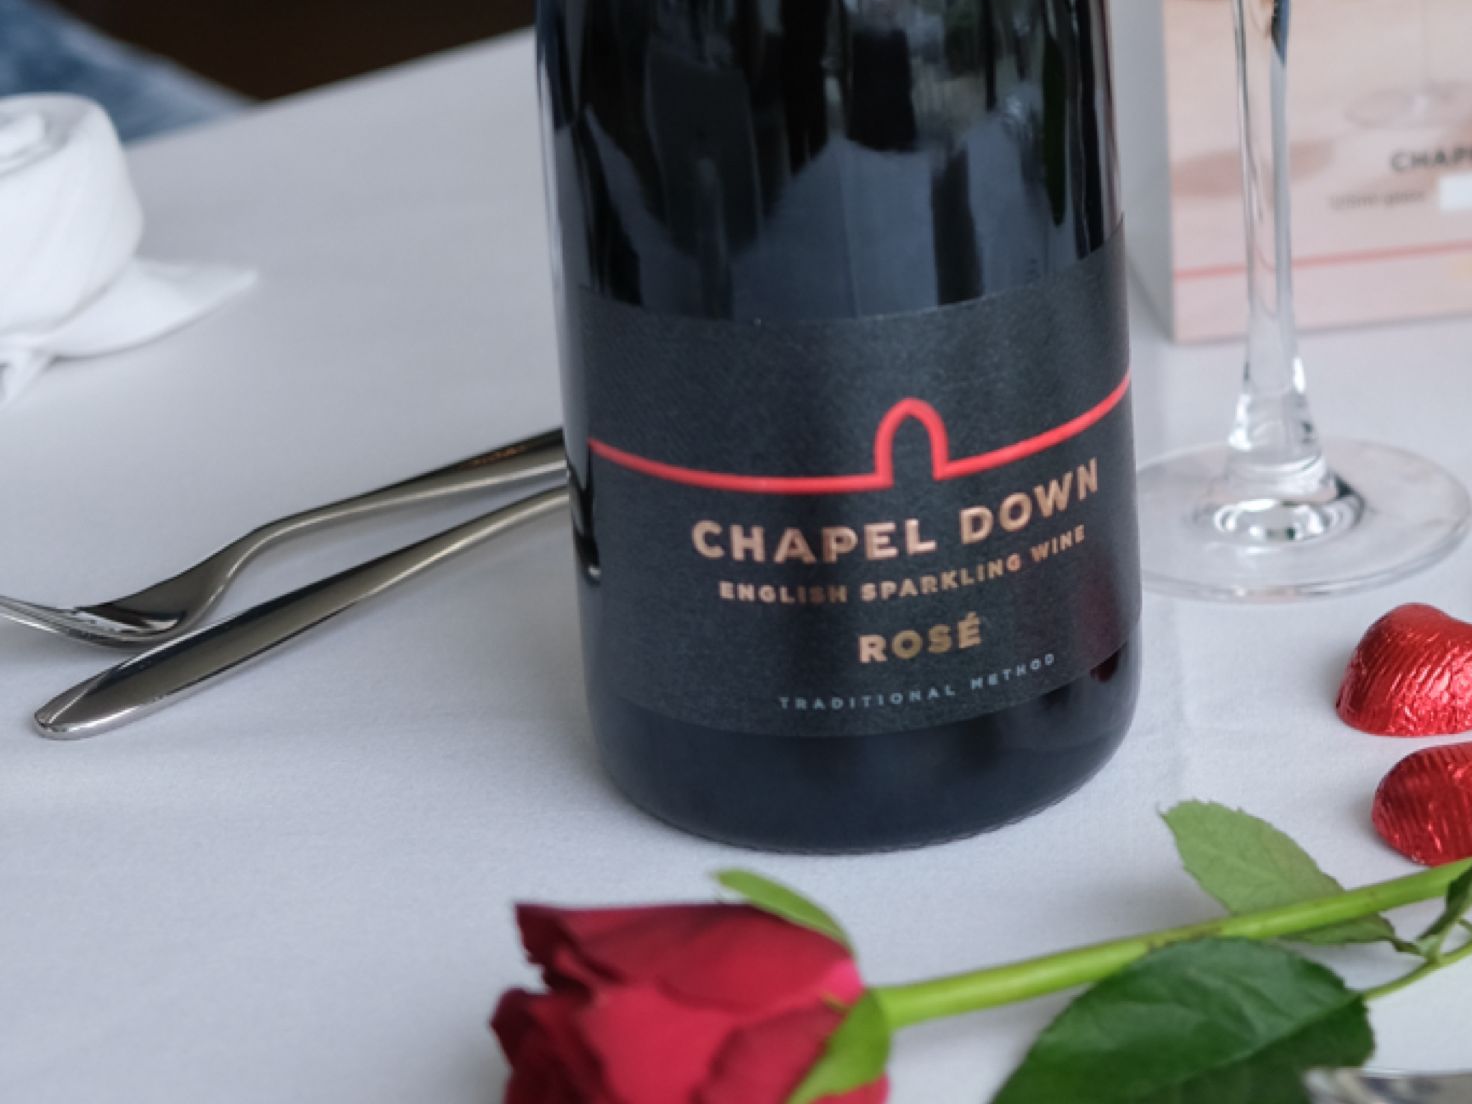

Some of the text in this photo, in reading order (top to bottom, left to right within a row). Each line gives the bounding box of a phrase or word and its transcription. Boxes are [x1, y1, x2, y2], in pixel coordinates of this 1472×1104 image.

[691, 456, 1099, 565] CHAPEL DOWN
[718, 523, 1086, 604] ENGLISH SPARKLING WINE
[857, 610, 983, 665] ROSÉ
[778, 652, 1055, 711] TRADITIONAL METHOD
